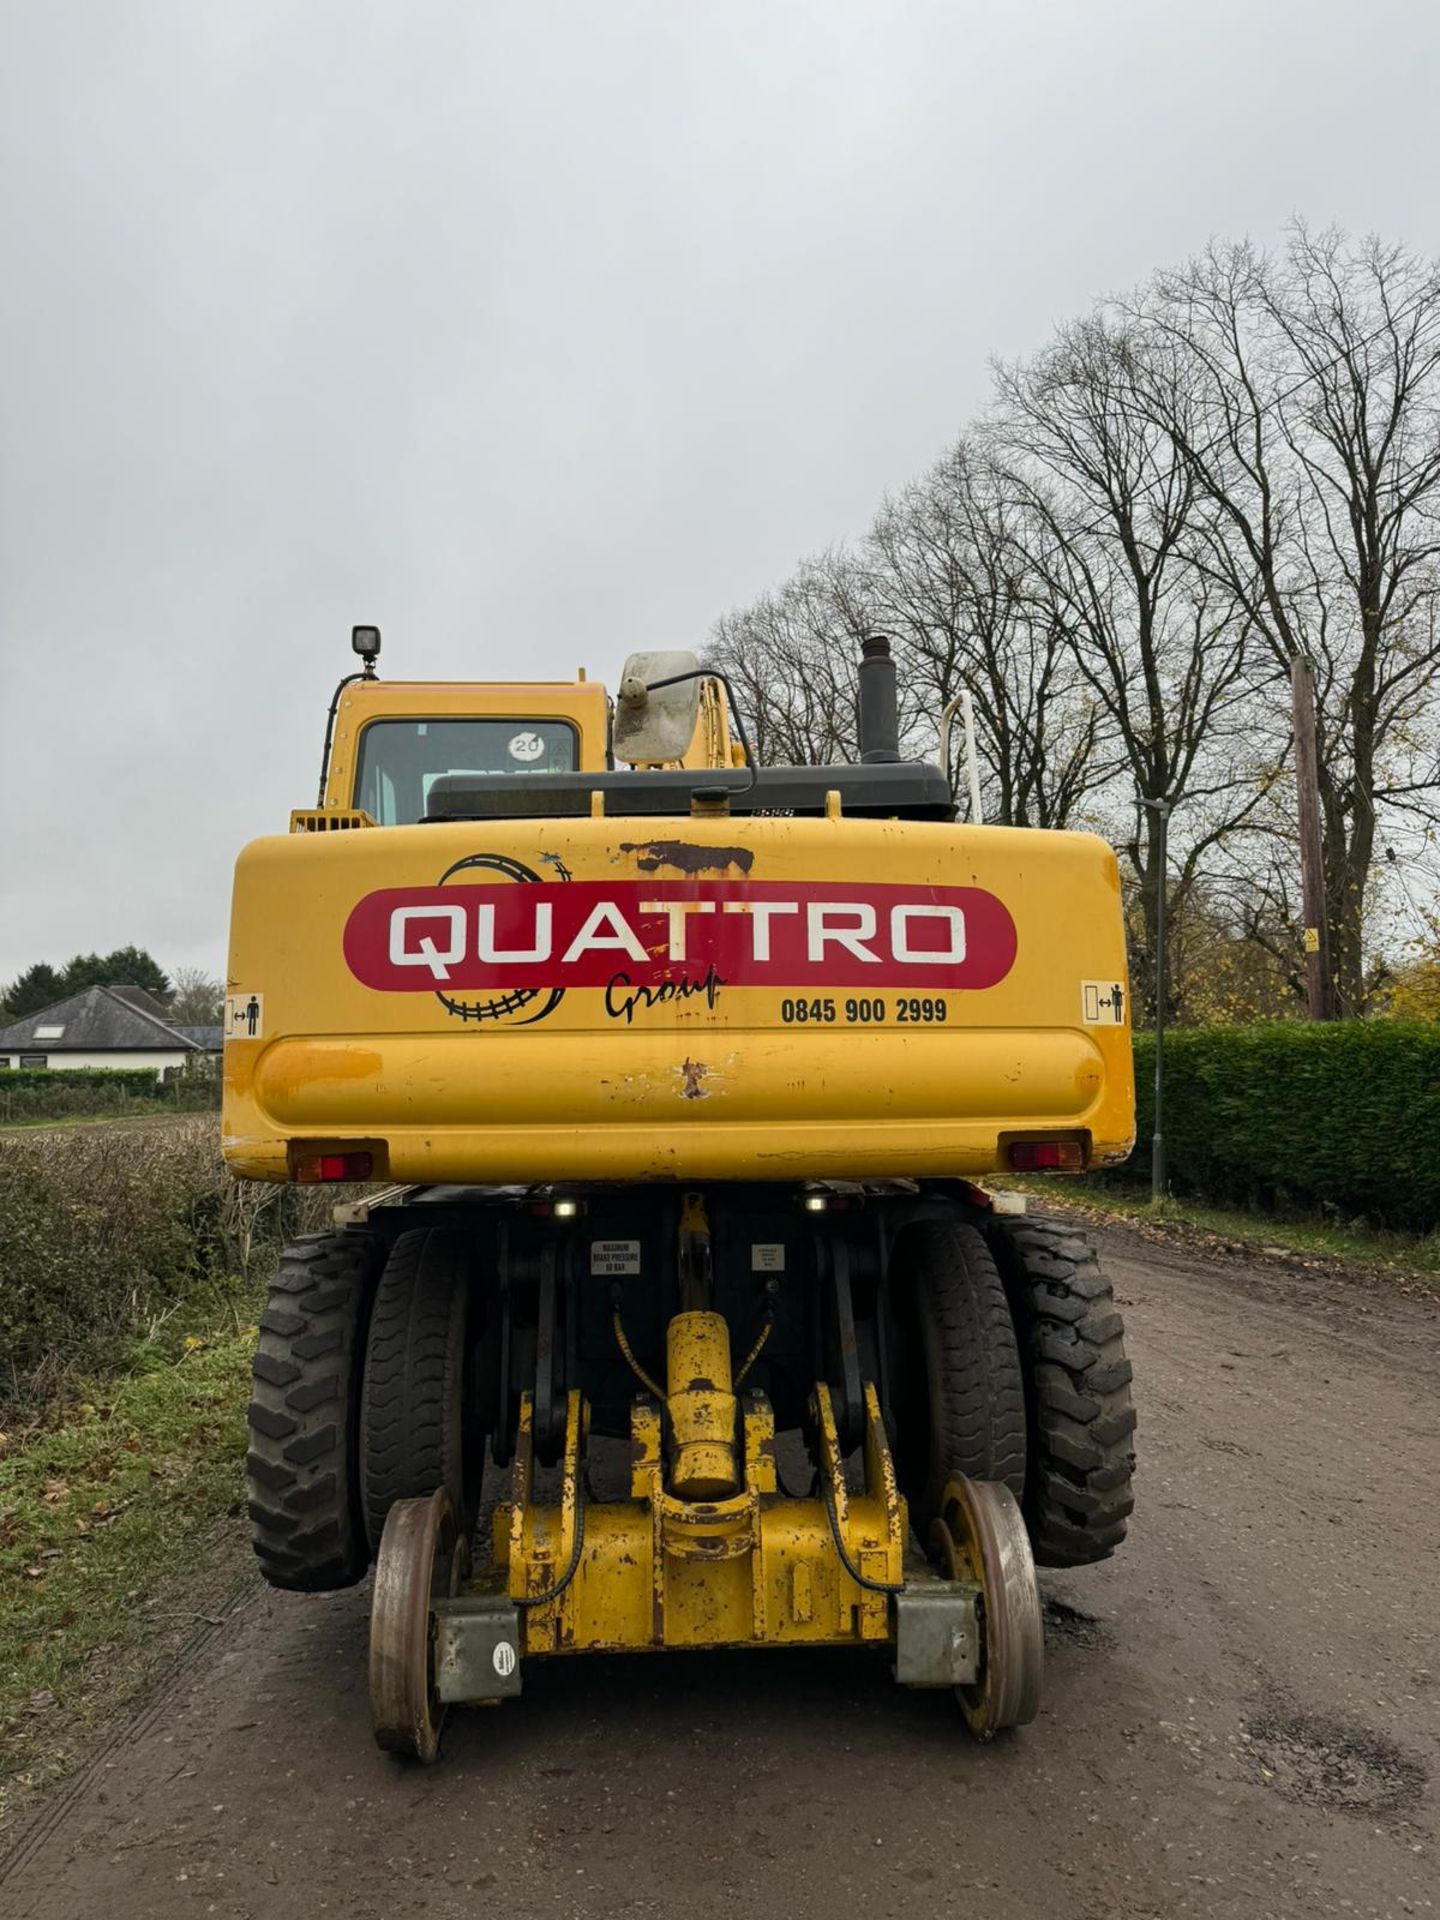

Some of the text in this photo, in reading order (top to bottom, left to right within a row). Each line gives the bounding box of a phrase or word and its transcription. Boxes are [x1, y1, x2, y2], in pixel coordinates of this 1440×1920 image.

[515, 740, 539, 752] 20
[389, 902, 967, 980] QUATTRO
[605, 963, 728, 1024] Group
[781, 998, 947, 1023] 0845 900 2999
